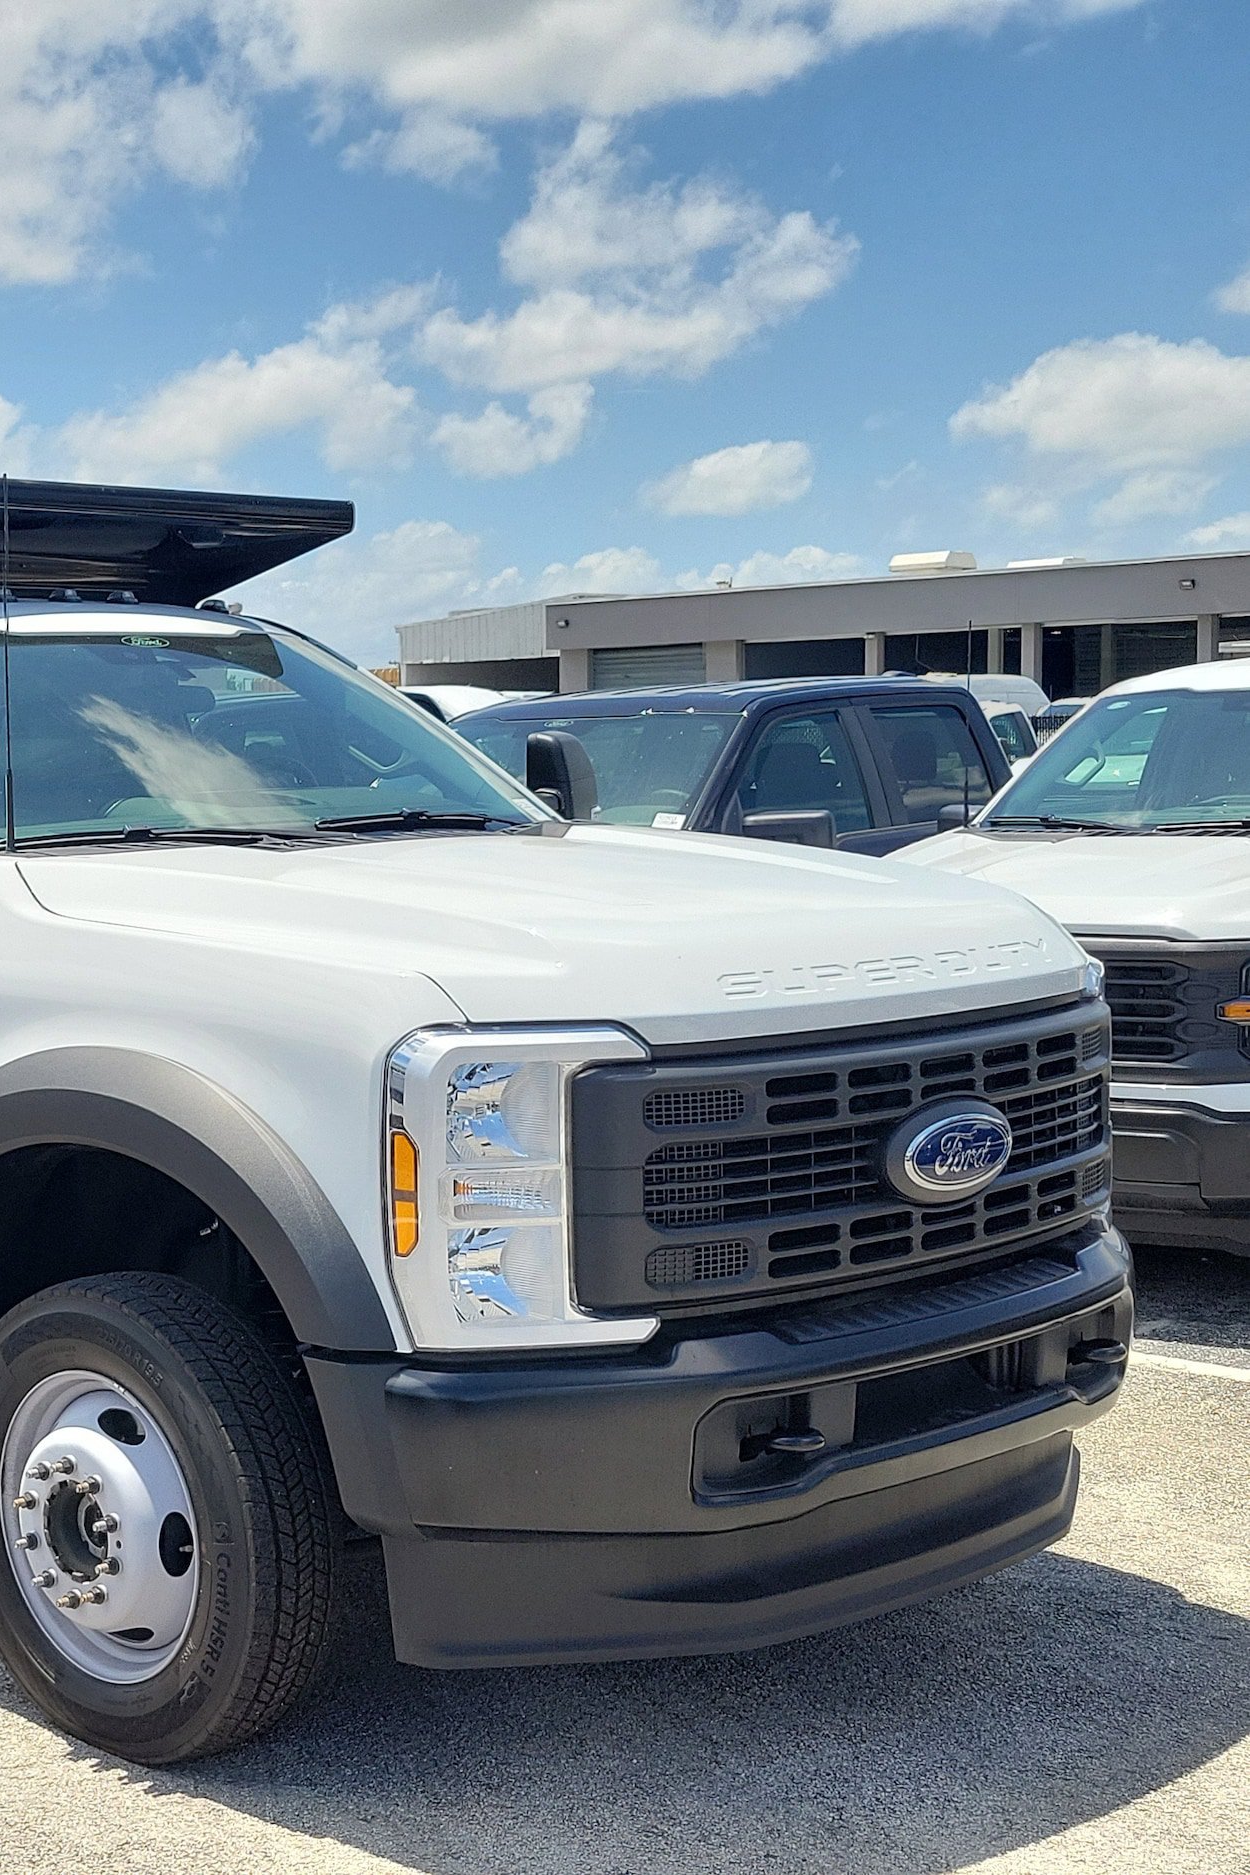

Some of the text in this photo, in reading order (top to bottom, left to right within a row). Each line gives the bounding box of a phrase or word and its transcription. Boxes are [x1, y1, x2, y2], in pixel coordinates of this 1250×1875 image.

[716, 938, 1052, 1000] SUPER DUTY
[934, 1129, 992, 1176] Ford
[207, 1614, 230, 1663] HSR
[200, 1660, 217, 1678] 5
